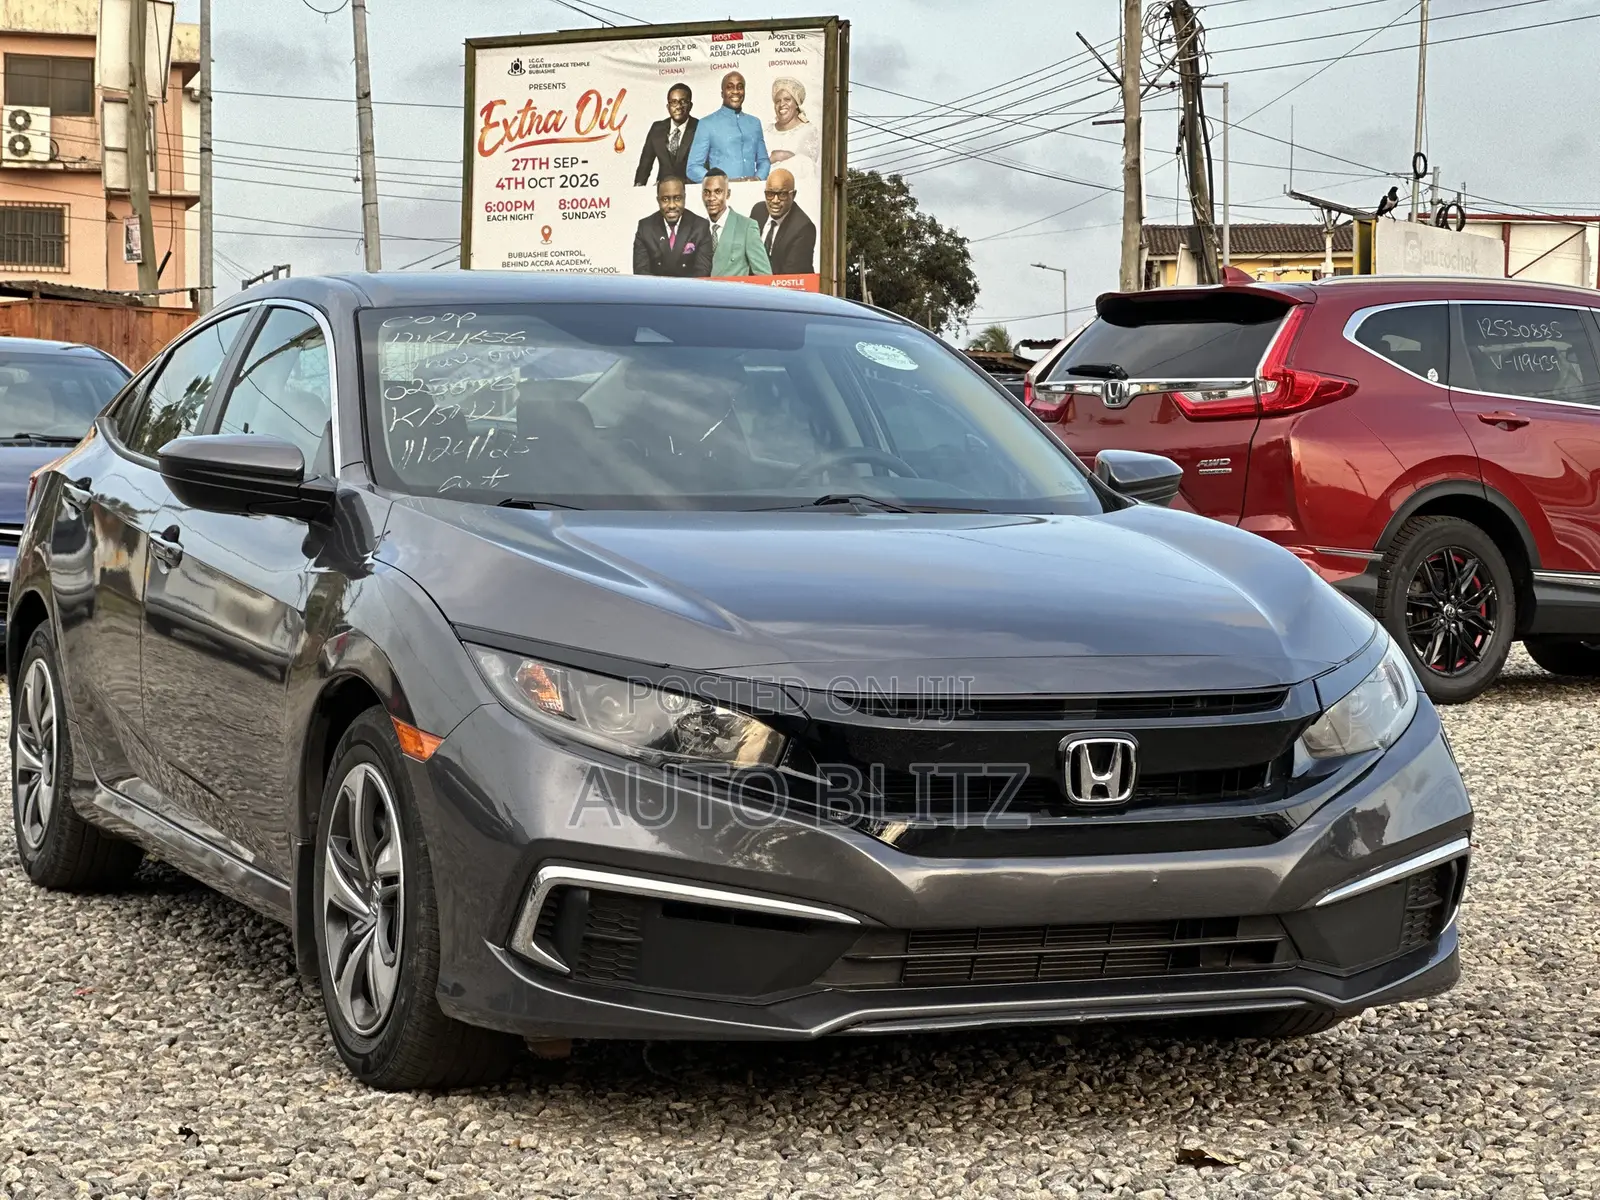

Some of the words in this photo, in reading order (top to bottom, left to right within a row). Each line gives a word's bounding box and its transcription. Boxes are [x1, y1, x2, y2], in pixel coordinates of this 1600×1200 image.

[710, 48, 760, 58] ADJEI-ACQUAH
[710, 62, 740, 70] (GHANA)
[768, 60, 808, 68] (BOSTWANA)
[528, 82, 566, 90] PRESENTS
[478, 98, 568, 157] Extra
[574, 88, 628, 136] Oil
[512, 158, 550, 171] 27TH
[496, 177, 525, 190] 4TH
[528, 176, 555, 189] OCT
[559, 174, 600, 188] 2026
[484, 200, 535, 213] 6:00PM
[558, 197, 610, 210] 8:00AM
[562, 210, 606, 220] SUNDAYS
[556, 258, 592, 266] ACADEMY,
[770, 278, 804, 287] APOSTLE
